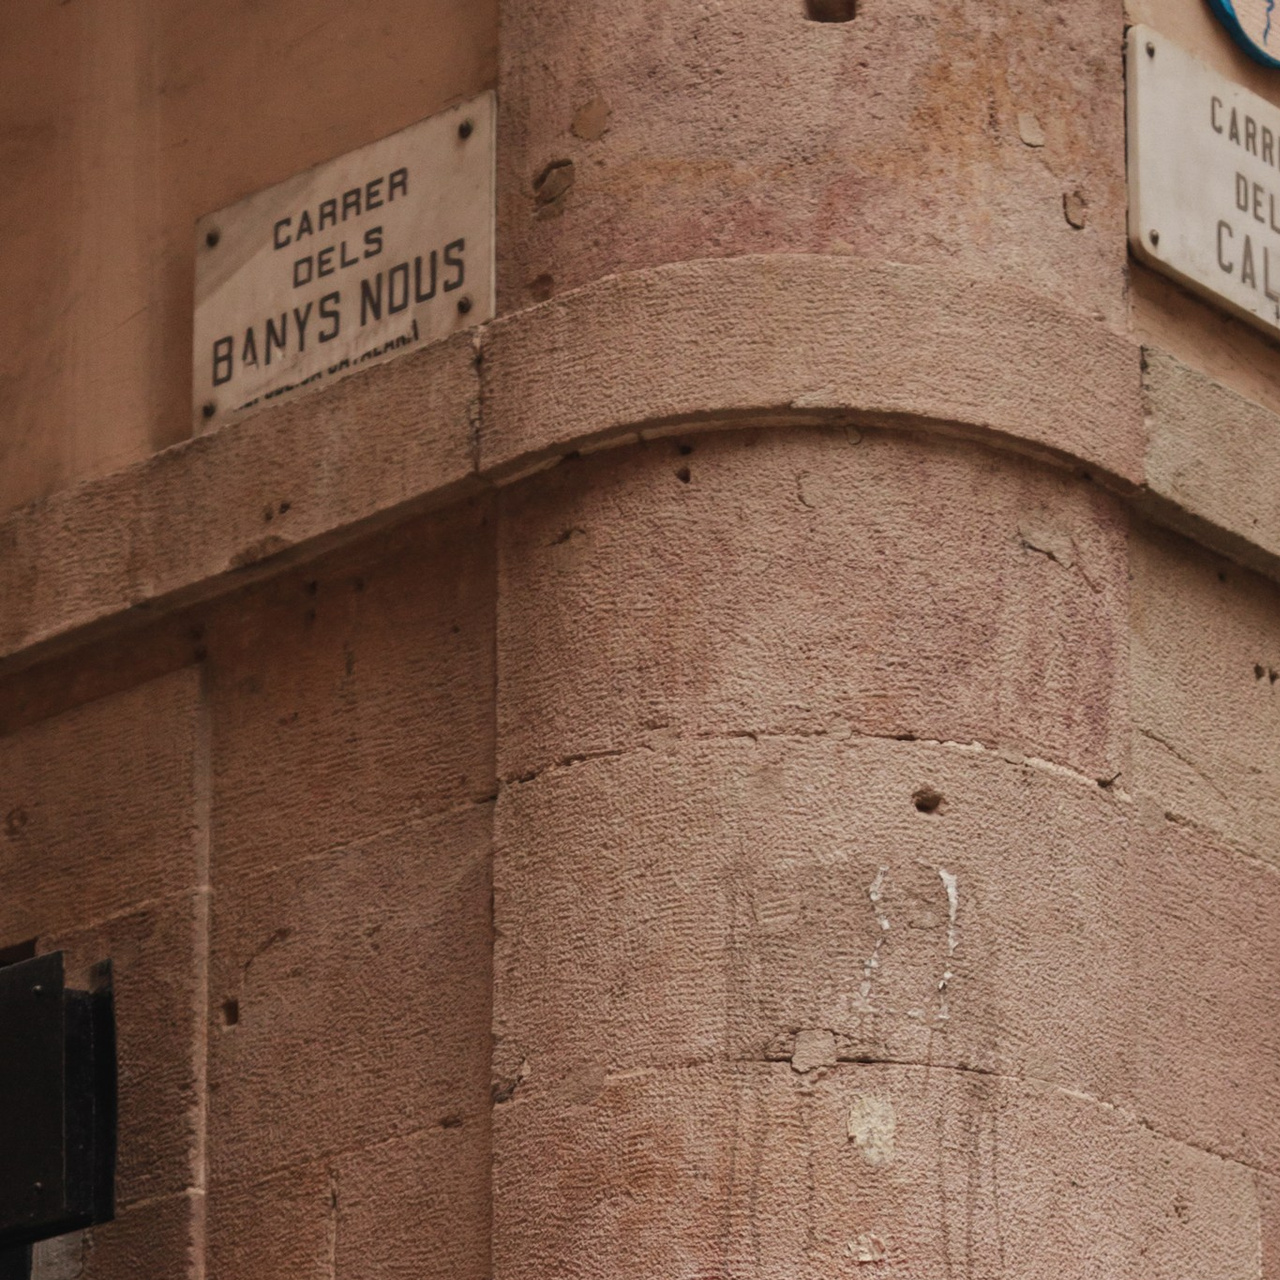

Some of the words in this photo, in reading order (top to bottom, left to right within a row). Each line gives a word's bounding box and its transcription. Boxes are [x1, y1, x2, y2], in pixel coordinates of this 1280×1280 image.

[273, 167, 408, 251] CARRER
[292, 225, 383, 289] DELS
[211, 290, 340, 387] BANYS
[360, 237, 466, 327] NOUS
